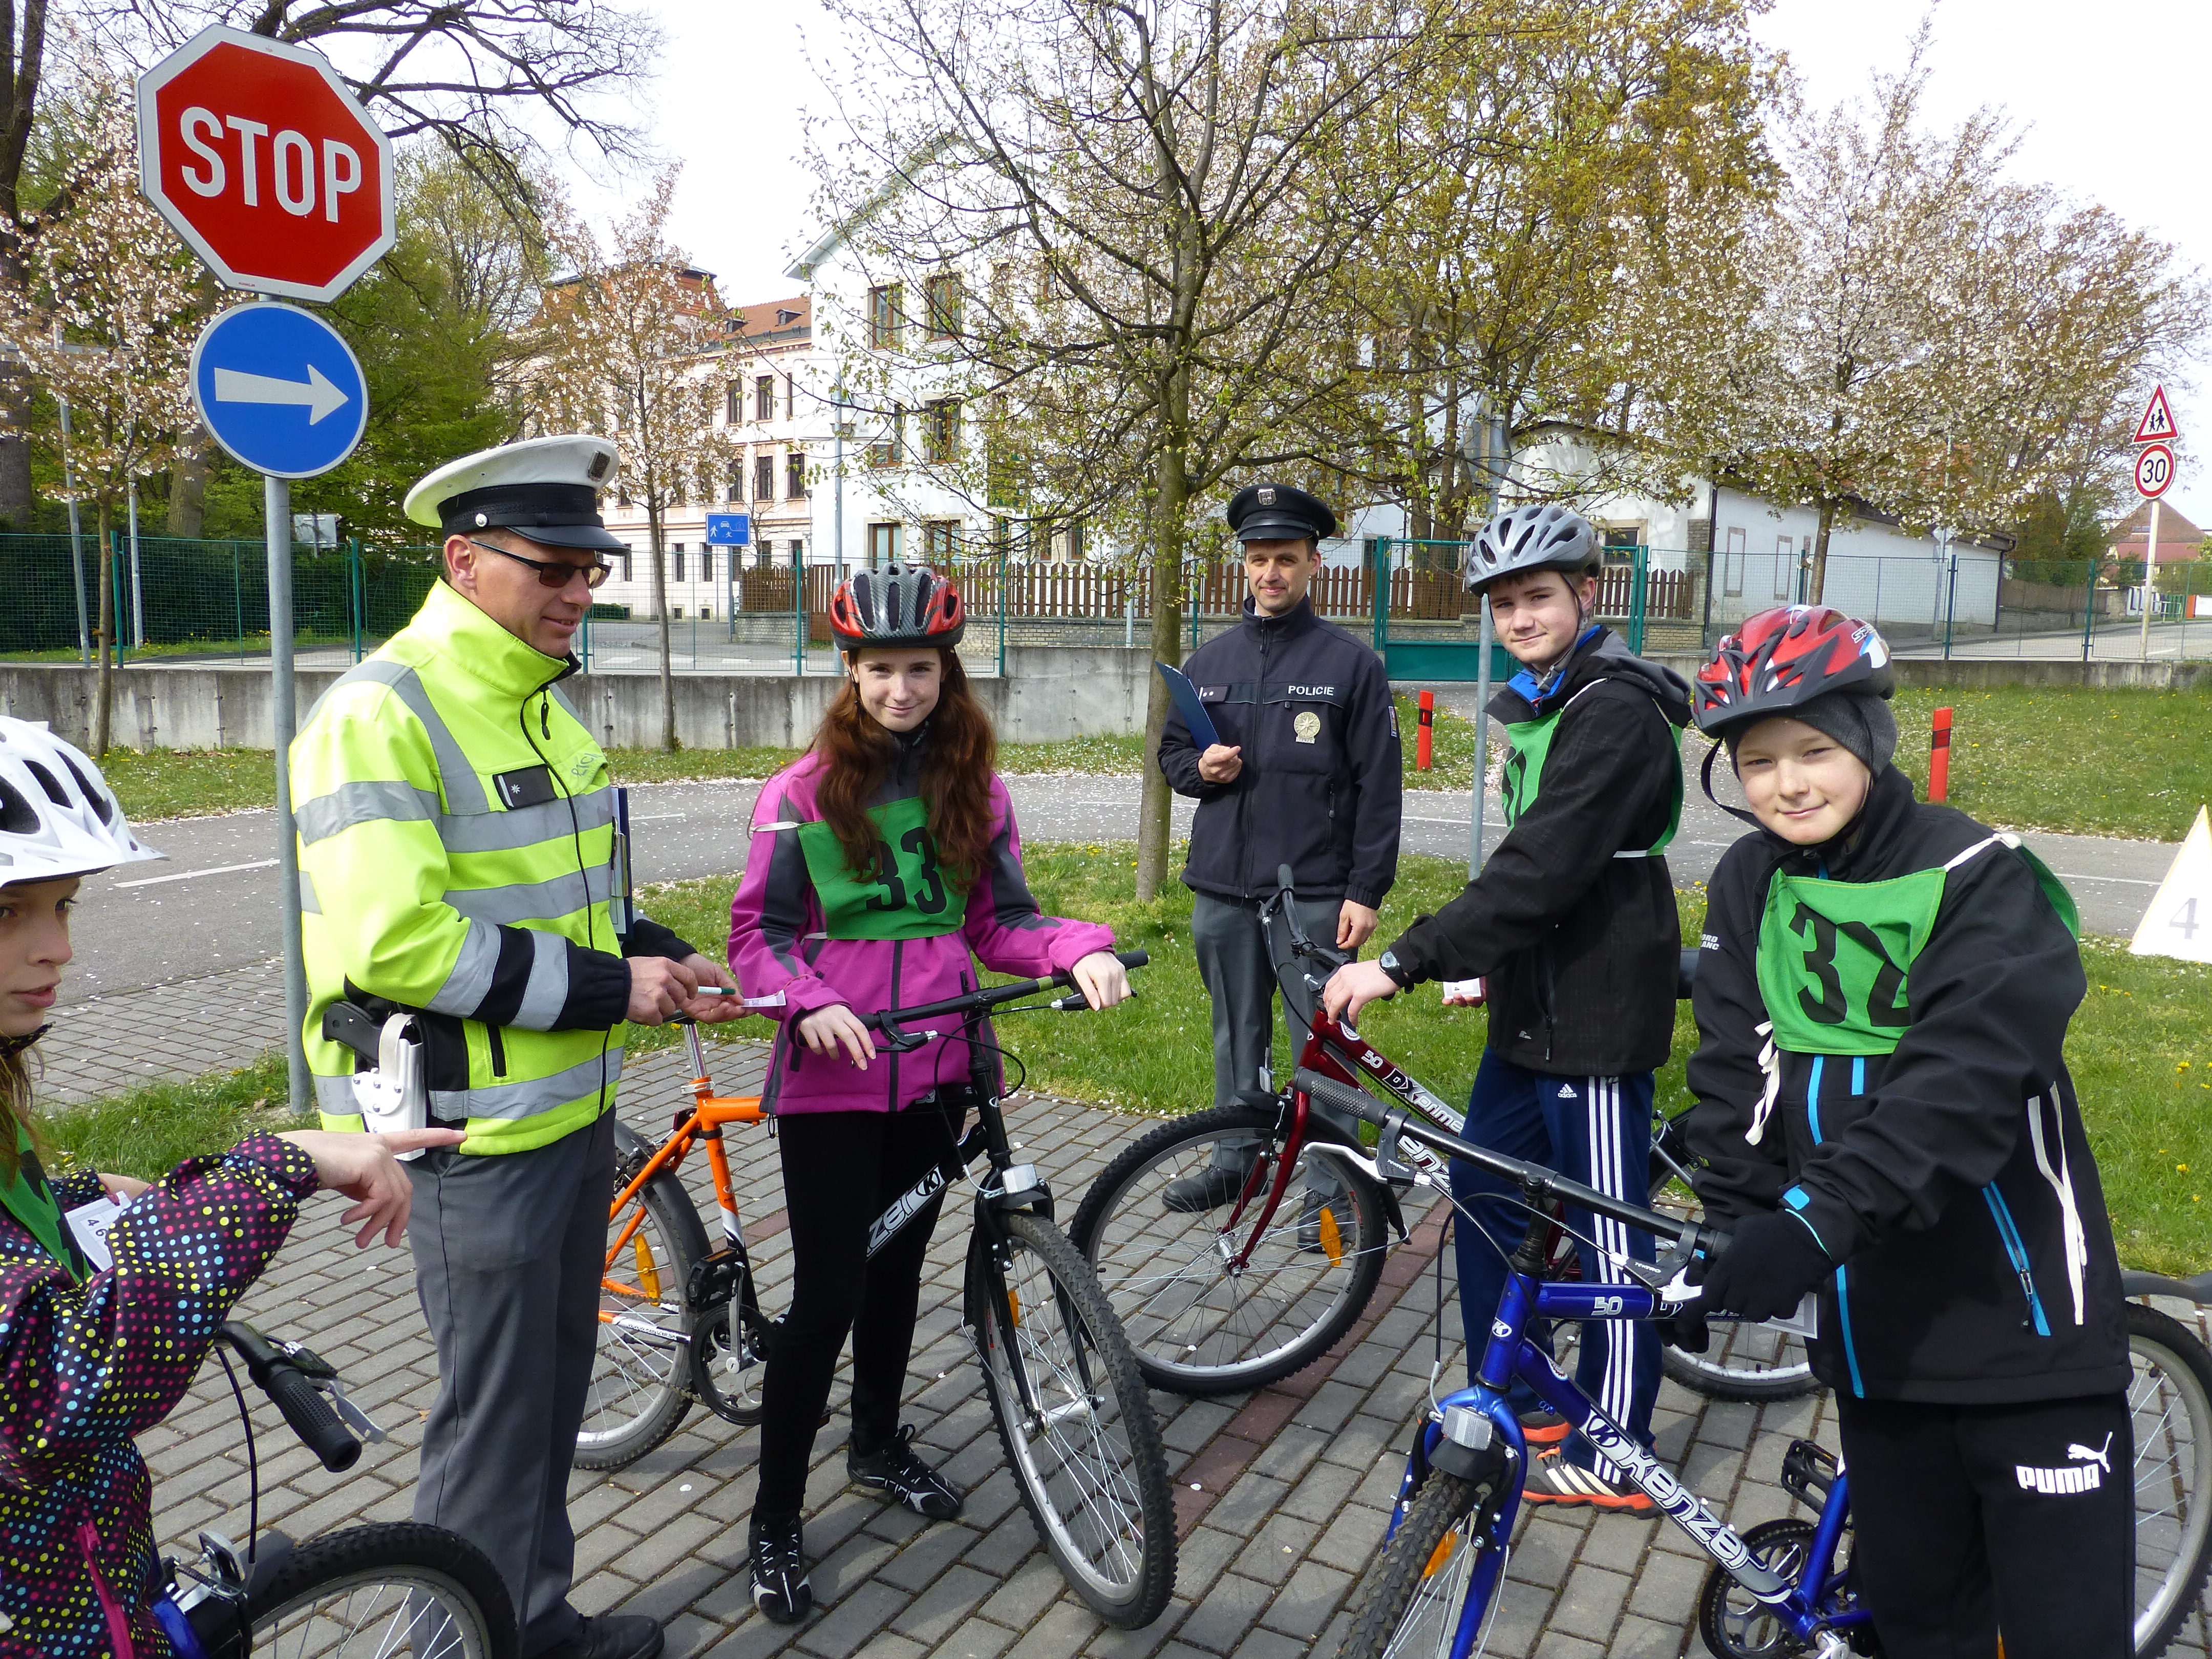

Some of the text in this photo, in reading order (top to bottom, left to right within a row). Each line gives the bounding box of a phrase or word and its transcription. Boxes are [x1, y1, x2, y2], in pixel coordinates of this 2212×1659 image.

[180, 107, 361, 223] STOP
[2142, 458, 2166, 483] 30
[1288, 685, 1334, 696] POLICIE
[866, 826, 947, 914] 33
[1701, 933, 1718, 943] ORD
[2169, 898, 2199, 940] 4
[1788, 902, 1912, 1028] 32
[1361, 1050, 1383, 1069] 50
[1414, 1095, 1465, 1133] prime
[1397, 1135, 1452, 1196] enz
[866, 1190, 914, 1258] zel
[1591, 1296, 1623, 1315] 50
[2016, 1463, 2100, 1494] PUMA
